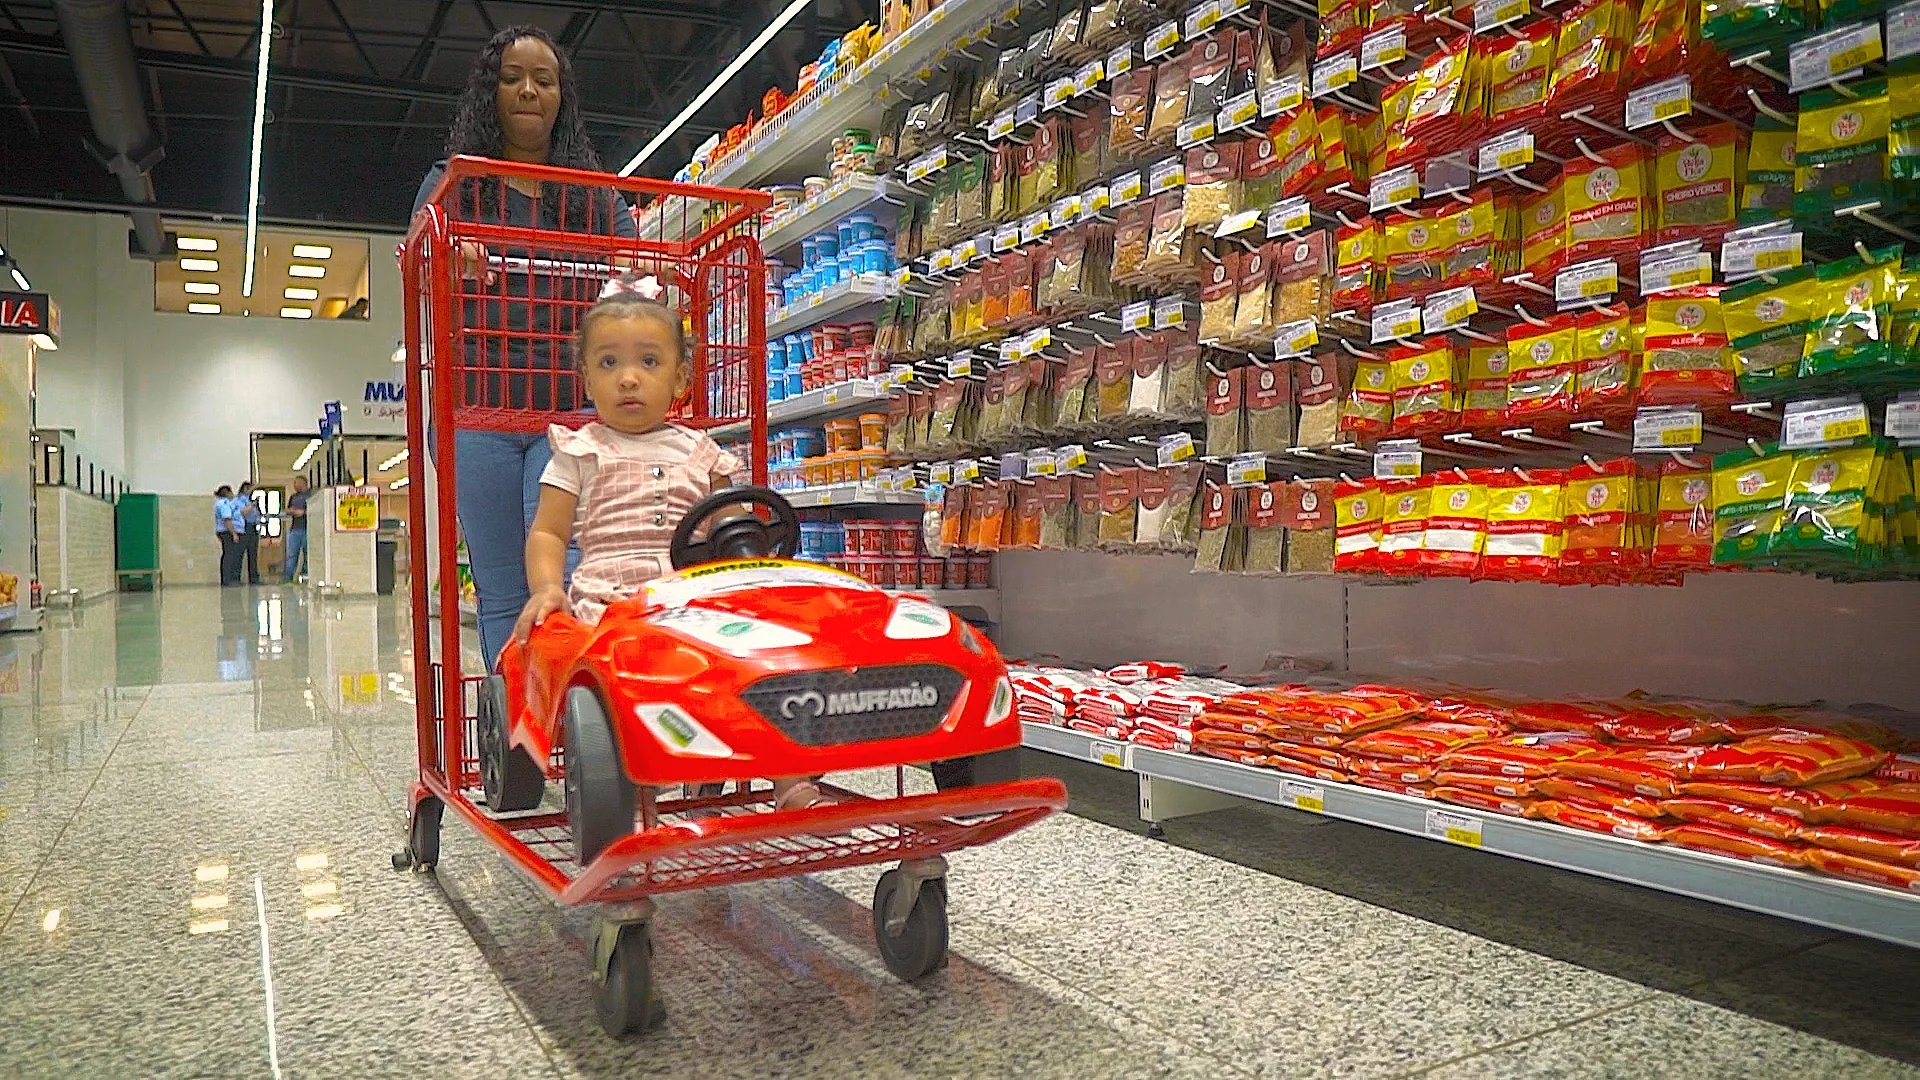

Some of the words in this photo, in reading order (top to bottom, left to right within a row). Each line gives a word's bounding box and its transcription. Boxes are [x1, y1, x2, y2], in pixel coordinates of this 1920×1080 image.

[1666, 188, 1693, 202] CHEIRO
[1694, 183, 1724, 196] VERDE
[1571, 207, 1601, 222] COMINHO
[1602, 203, 1613, 215] EM
[828, 681, 939, 716] MUFFATÃO
